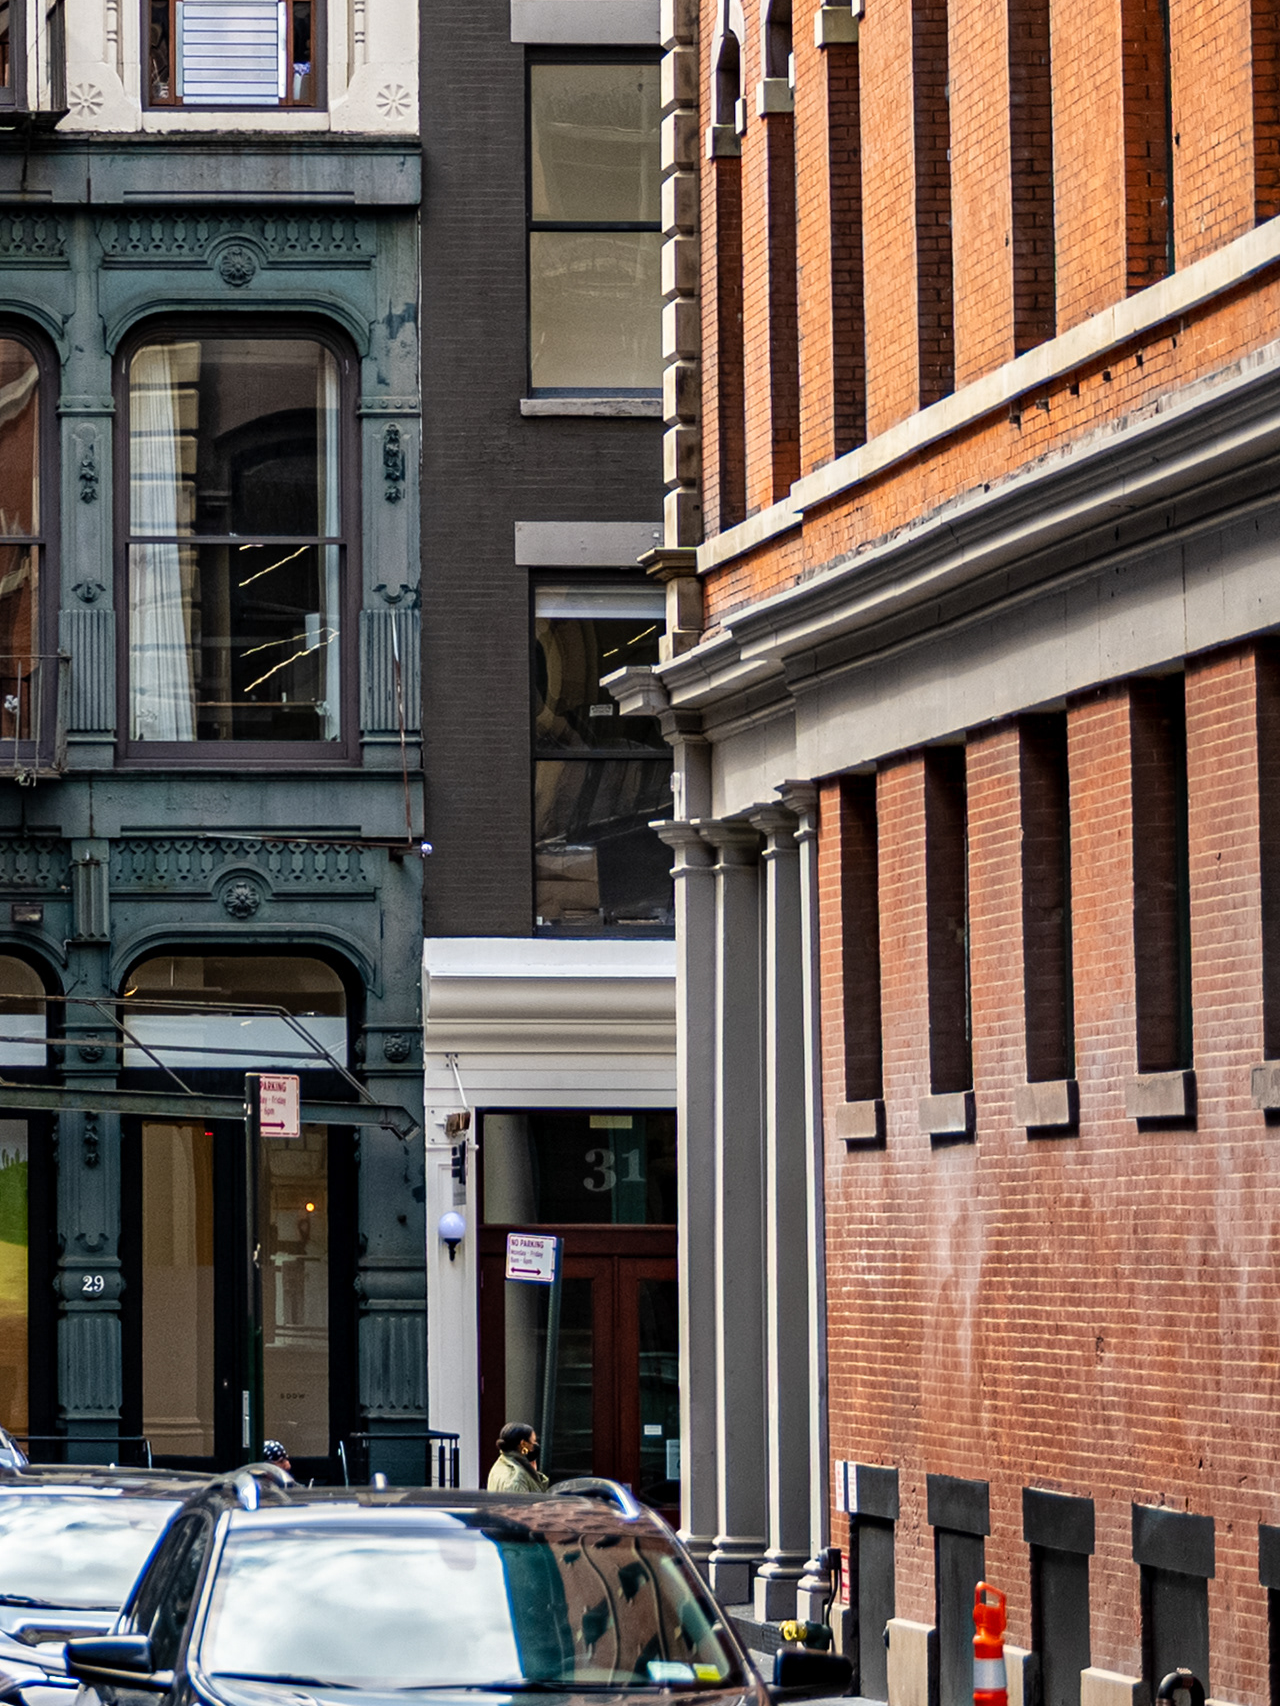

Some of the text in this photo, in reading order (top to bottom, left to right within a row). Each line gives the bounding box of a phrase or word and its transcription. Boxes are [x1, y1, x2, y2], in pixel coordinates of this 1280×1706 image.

[583, 1148, 646, 1192] 31
[511, 1238, 545, 1249] NO PARKING
[81, 1276, 105, 1293] 29
